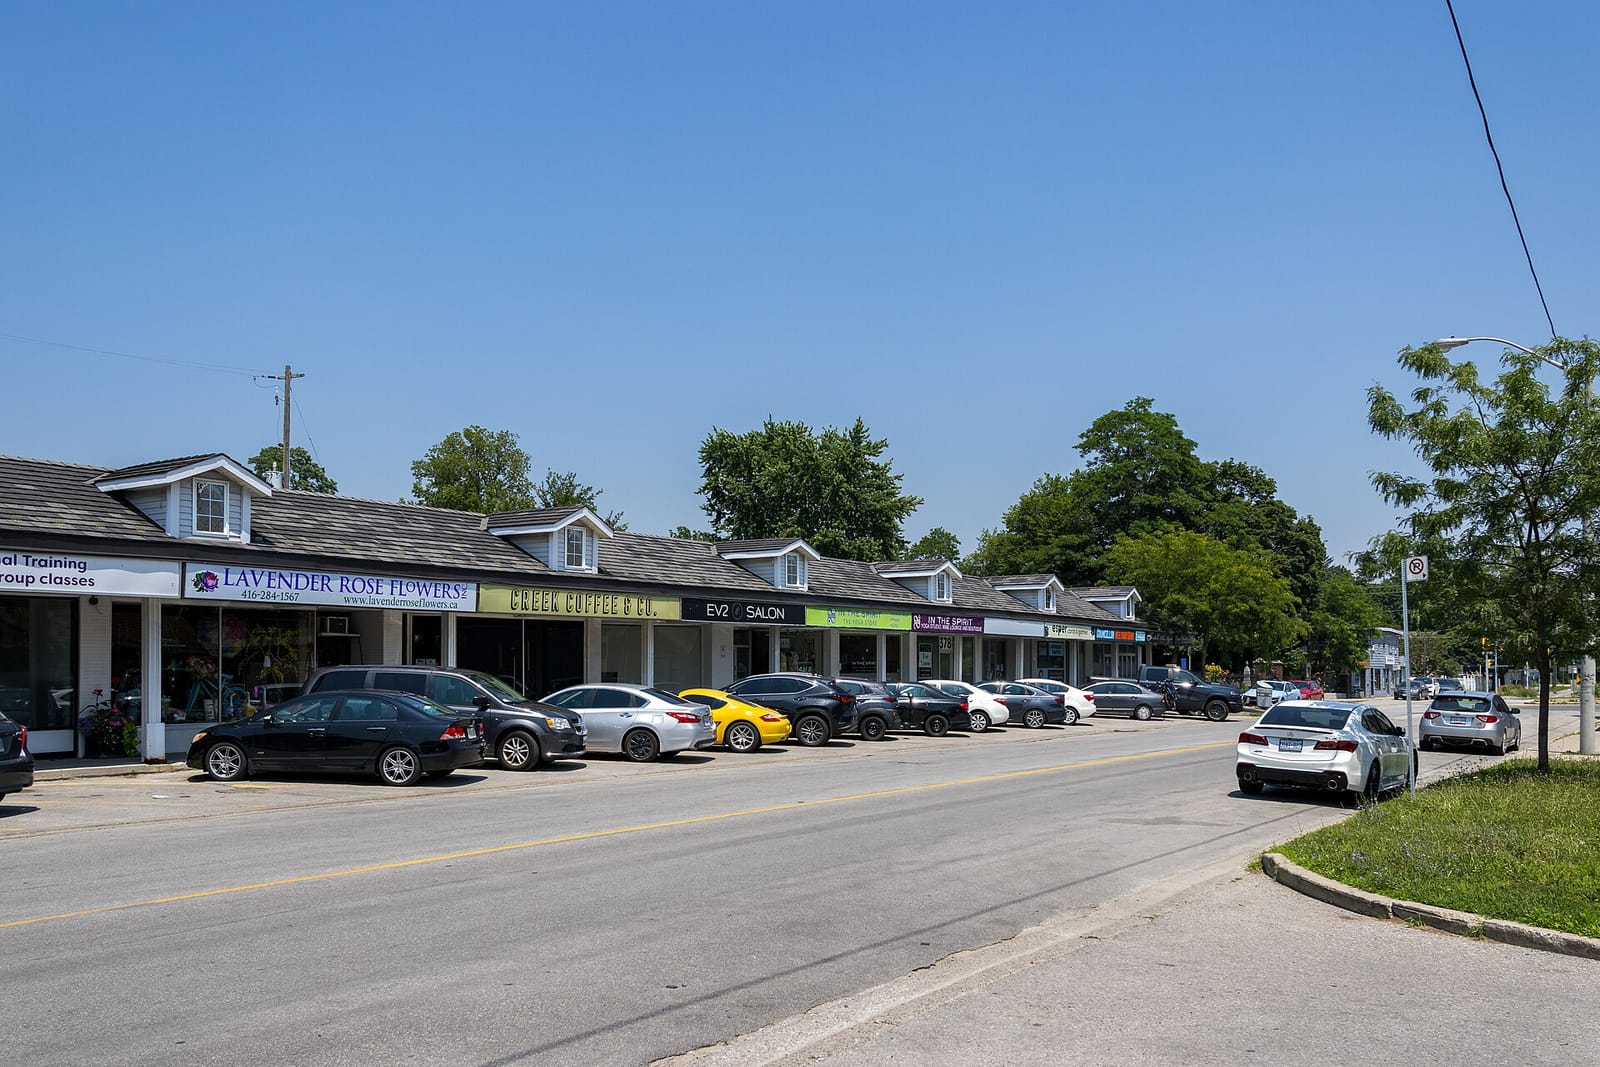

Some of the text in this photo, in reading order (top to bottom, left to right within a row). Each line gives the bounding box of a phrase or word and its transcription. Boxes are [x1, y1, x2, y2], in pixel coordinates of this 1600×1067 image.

[0, 554, 87, 573] al Training
[39, 573, 95, 587] classes
[223, 567, 461, 600] LAVENDER ROSE FLOWERS
[241, 590, 300, 601] 416-284-1567
[343, 596, 458, 609] www.lavenderroseflowers.ca
[510, 588, 658, 616] CREEK COFFEE & CO.
[706, 603, 785, 620] EV2 SALON
[928, 616, 973, 626] IN THE SPIRIT
